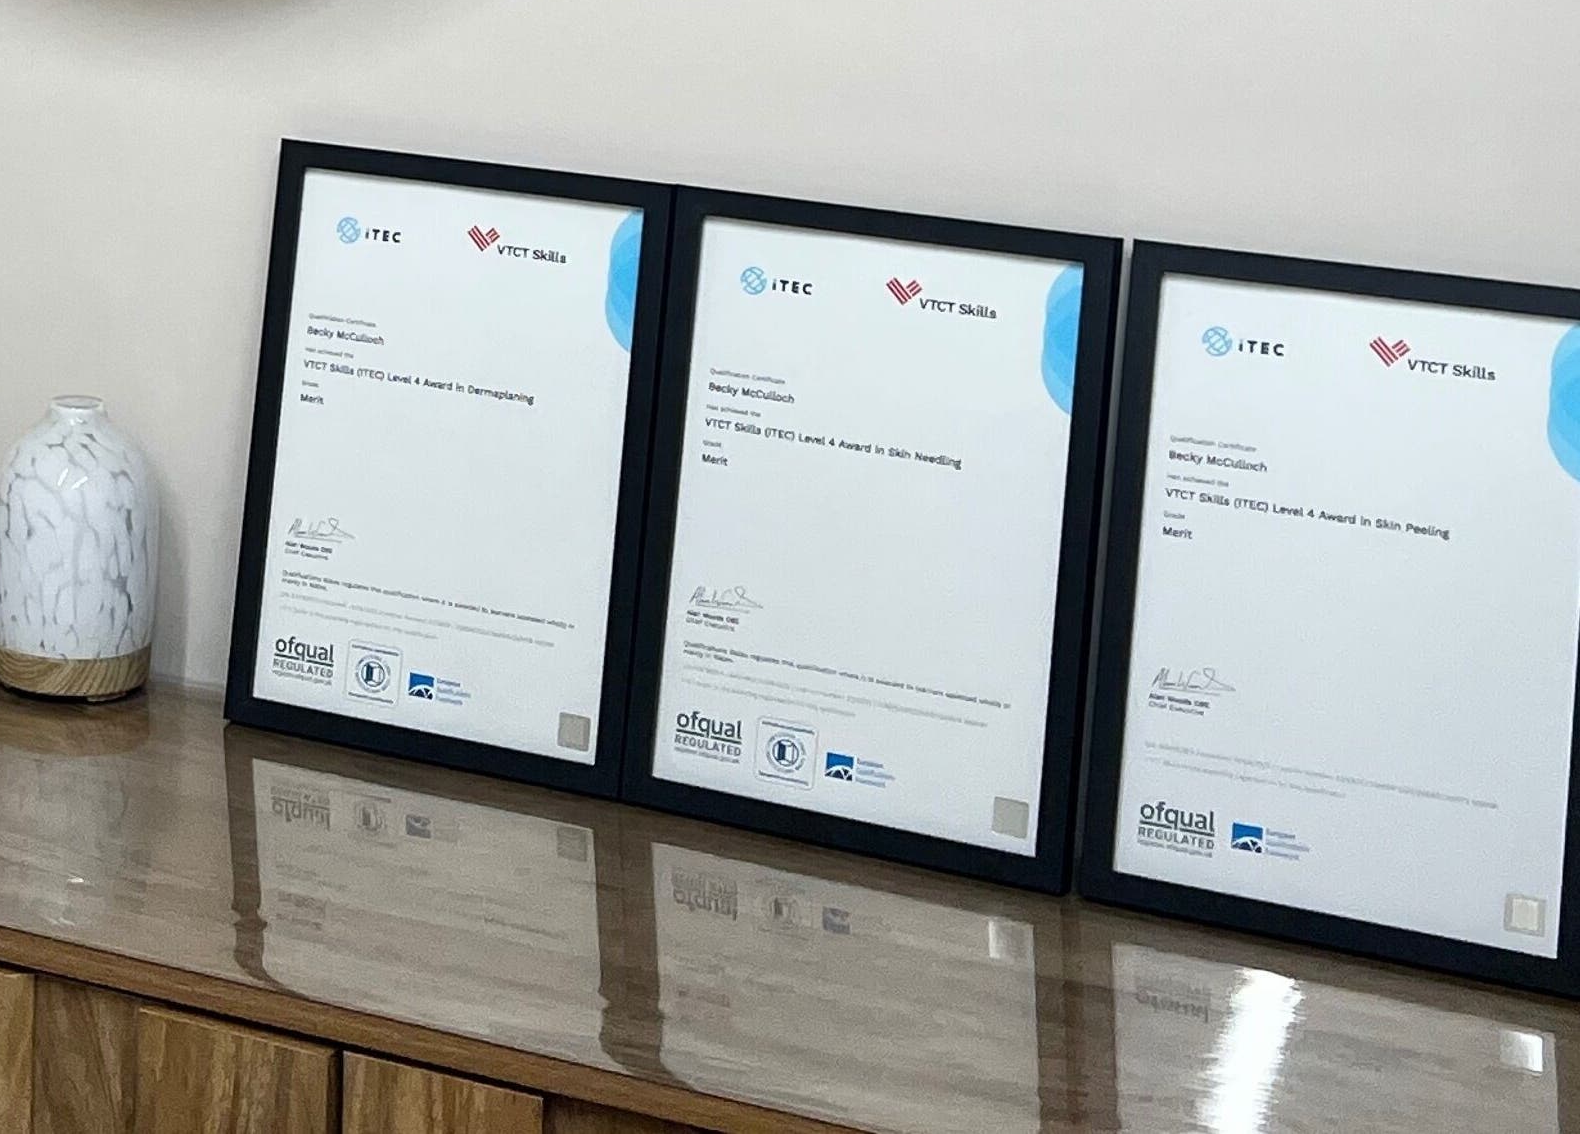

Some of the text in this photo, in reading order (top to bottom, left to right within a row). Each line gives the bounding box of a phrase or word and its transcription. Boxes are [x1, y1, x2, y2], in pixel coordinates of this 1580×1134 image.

[365, 227, 402, 245] iTEC
[496, 244, 567, 265] VTCT Skills
[771, 278, 813, 296] iTEC
[919, 298, 997, 320] VTCT Skills
[307, 325, 385, 346] Becky McCulloch
[1238, 339, 1285, 357] iTEC
[1407, 358, 1496, 382] VTCT Skills
[303, 359, 328, 371] VTCT
[329, 362, 355, 376] Skills
[387, 371, 412, 385] Level
[422, 378, 453, 392] Award
[455, 382, 465, 394] in
[467, 384, 535, 407] Dermaplaning
[708, 381, 795, 404] Becky McCulloch
[299, 393, 325, 406] Merit
[705, 417, 732, 430] VTCT
[734, 421, 762, 436] Skills
[798, 432, 826, 447] Level
[838, 439, 872, 454] Award
[875, 443, 885, 455] in
[888, 445, 911, 460] Skin
[914, 451, 962, 471] Needling
[702, 453, 729, 467] Merit
[1168, 449, 1268, 473] Becky McCulloch
[1165, 487, 1196, 502] VTCT
[1199, 492, 1230, 508] Skills
[1272, 503, 1304, 518] Level
[1307, 508, 1315, 519] 4
[1318, 510, 1357, 526] Award
[1360, 514, 1372, 527] in
[1375, 517, 1402, 532] Skin
[1405, 521, 1450, 541] Peeling
[1162, 525, 1193, 541] Merit
[275, 636, 334, 663] ofqual
[273, 658, 334, 679] REGULATED
[676, 711, 742, 739] ofqual
[674, 733, 741, 757] REGULATED
[1140, 801, 1215, 833] ofqual
[1138, 826, 1215, 851] REGULATED
